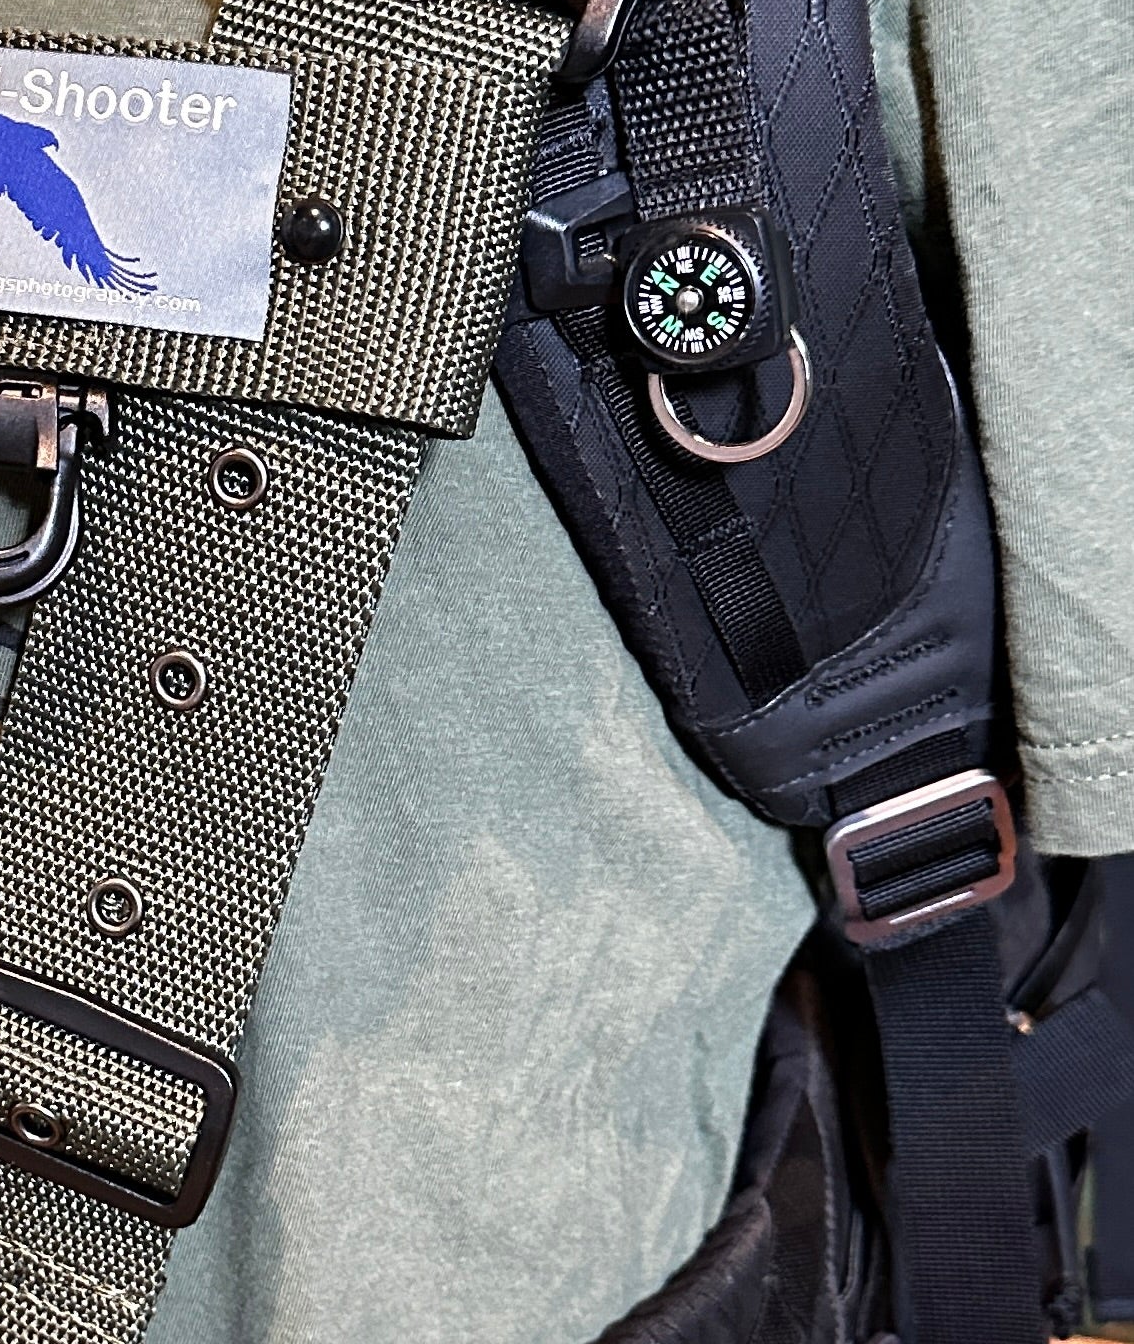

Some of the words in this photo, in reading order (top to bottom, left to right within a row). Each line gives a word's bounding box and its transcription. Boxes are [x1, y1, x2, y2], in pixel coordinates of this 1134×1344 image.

[675, 259, 694, 274] NE
[699, 264, 721, 287] E
[659, 274, 680, 296] N
[717, 286, 732, 304] SE
[707, 311, 727, 330] S
